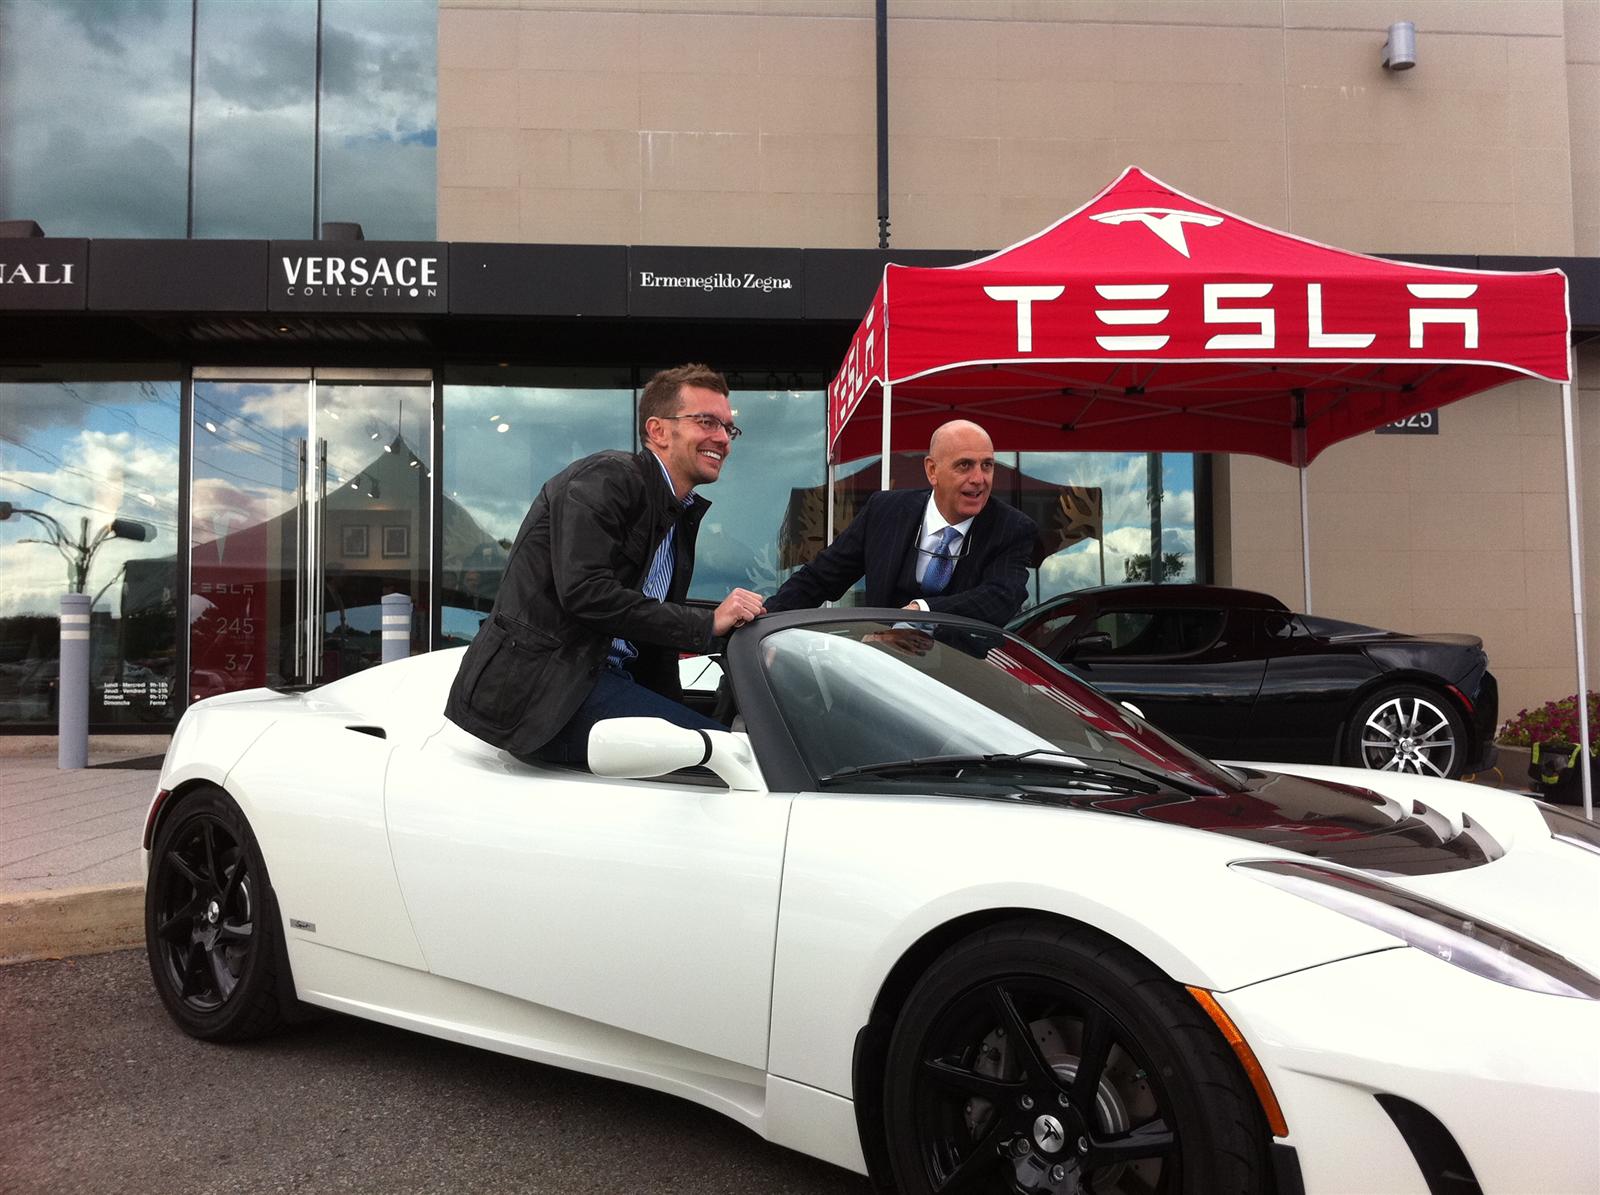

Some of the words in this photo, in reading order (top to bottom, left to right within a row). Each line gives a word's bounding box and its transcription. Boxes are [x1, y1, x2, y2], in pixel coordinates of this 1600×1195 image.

[0, 263, 74, 284] ALI
[282, 257, 437, 286] VERSACE
[287, 287, 437, 297] COLLECTION
[640, 272, 741, 292] Ermenegildo
[743, 273, 792, 292] Zegna
[983, 283, 1479, 352] TESLA
[833, 305, 874, 432] TESLA
[216, 617, 254, 634] 245
[224, 654, 254, 671] 3.7
